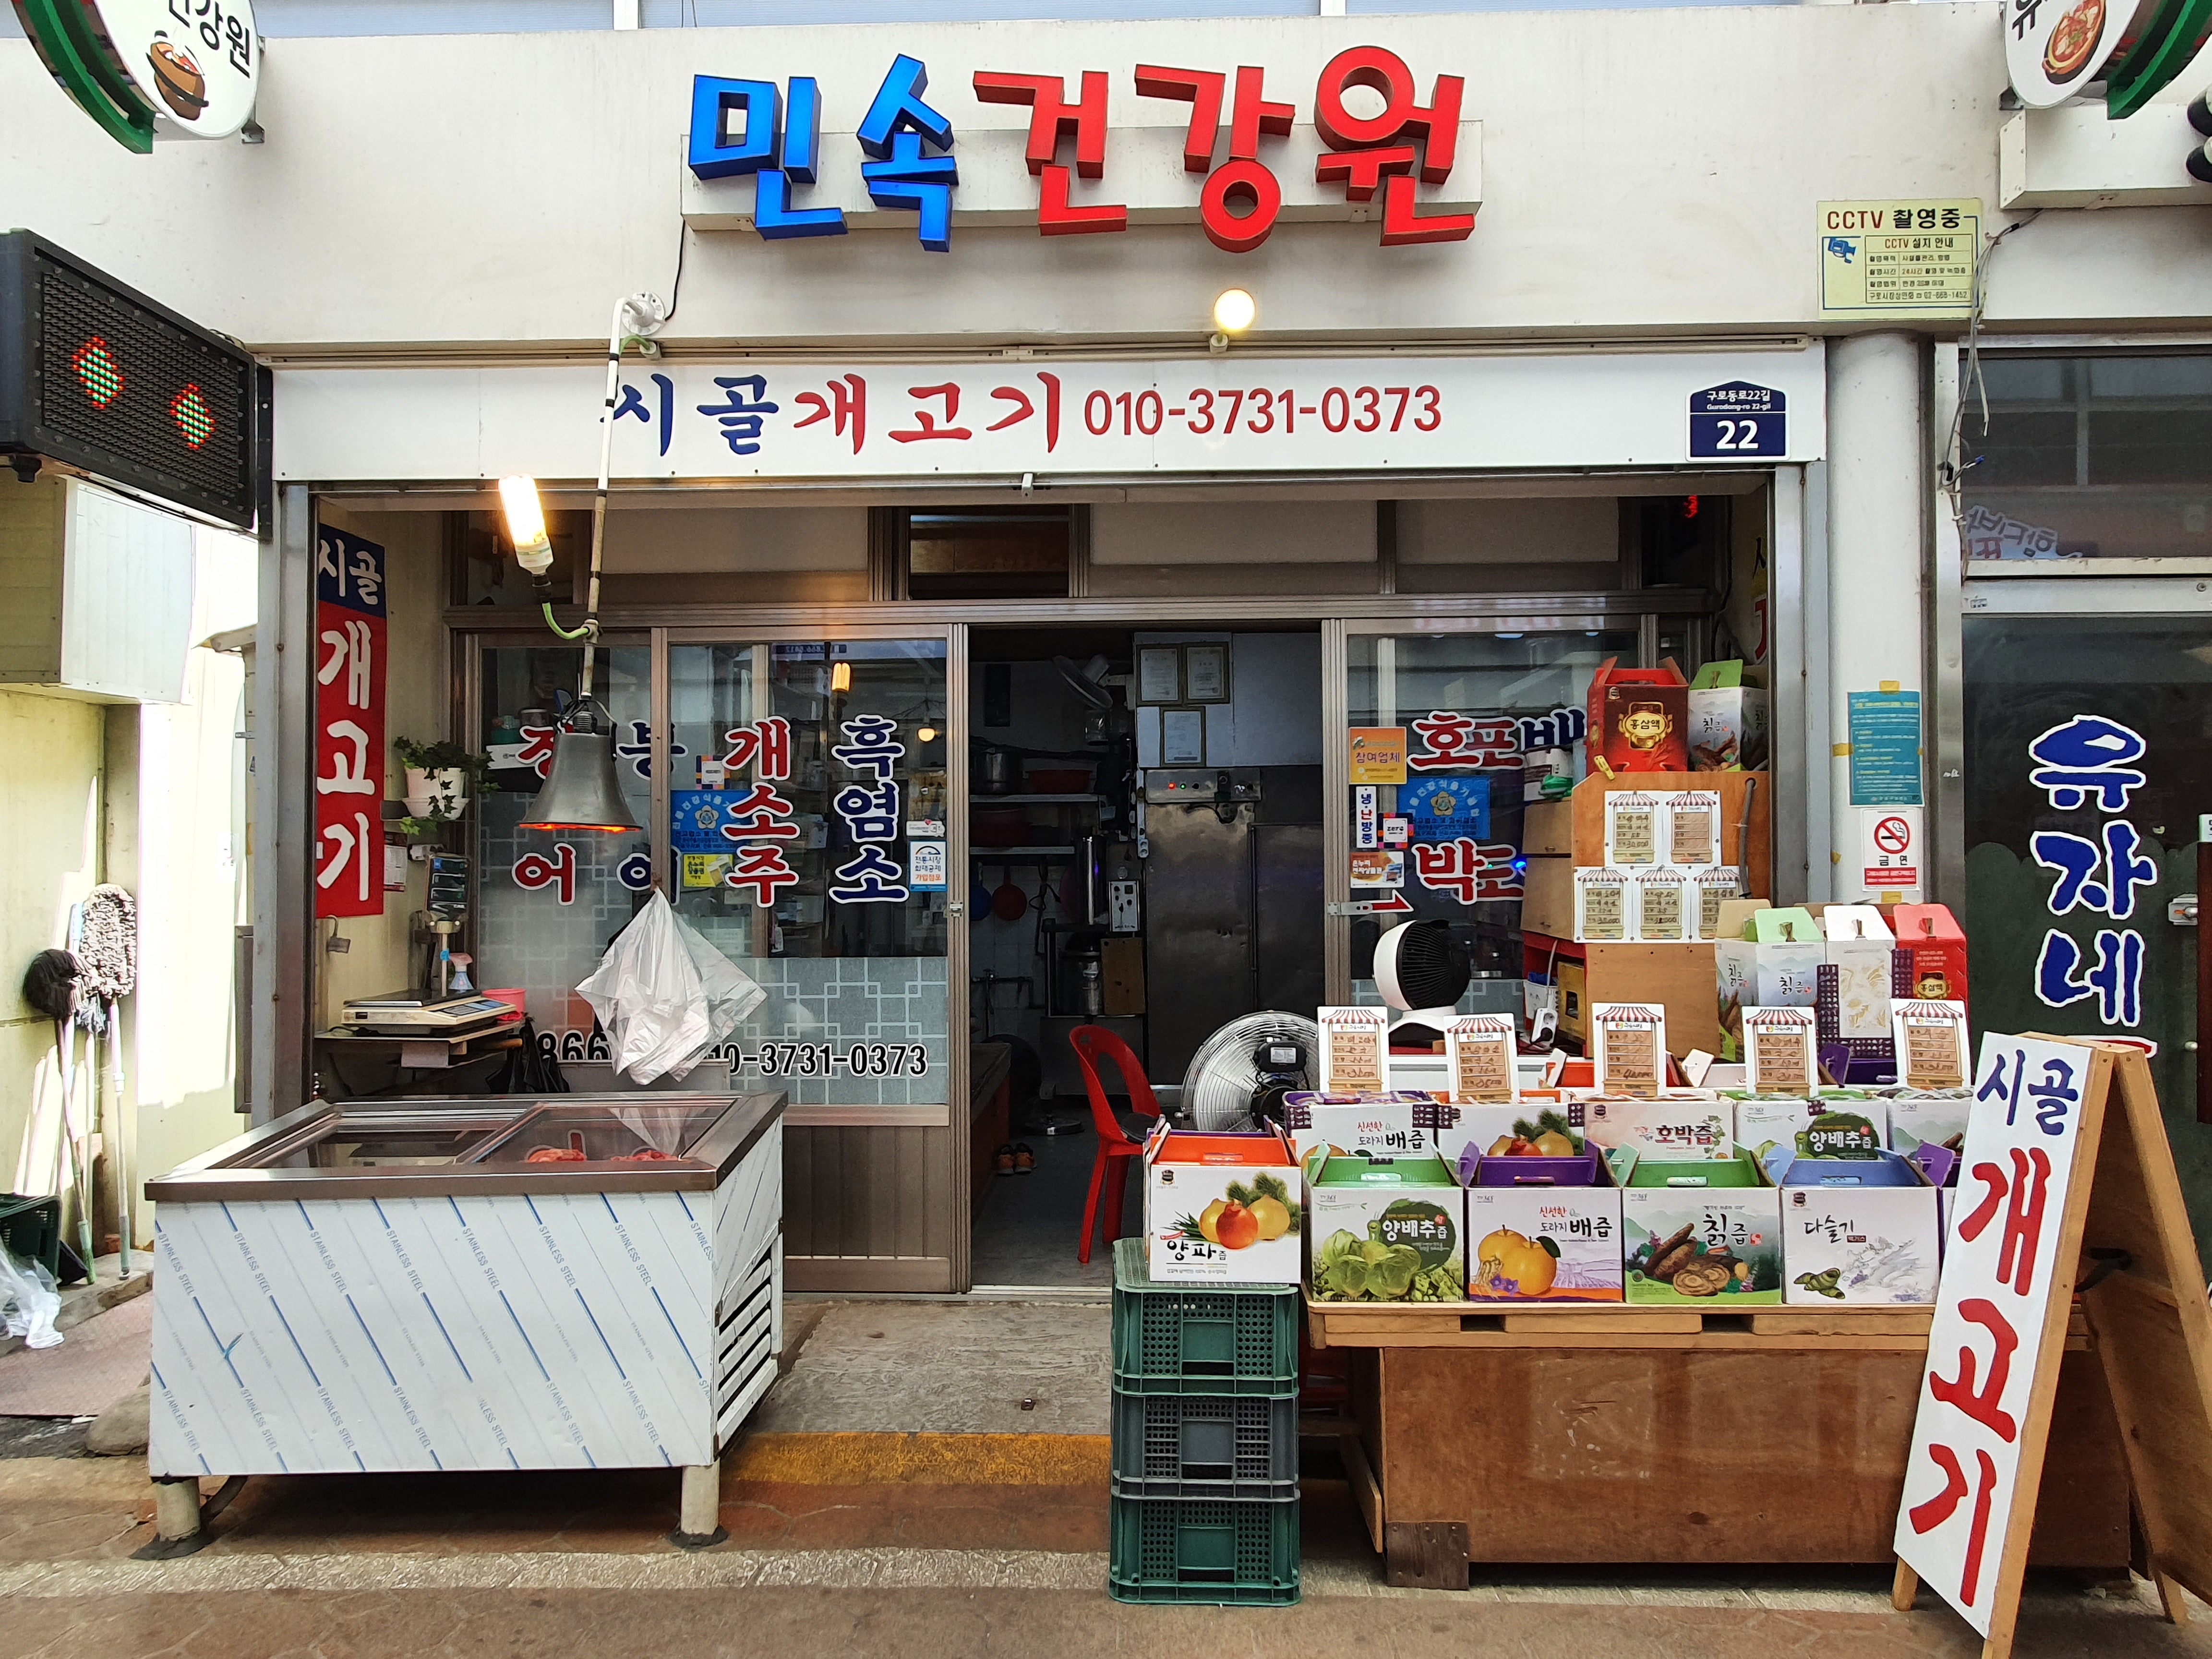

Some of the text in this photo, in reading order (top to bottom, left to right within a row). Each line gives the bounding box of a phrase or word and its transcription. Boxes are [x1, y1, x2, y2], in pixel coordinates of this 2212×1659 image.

[1827, 208, 1960, 229] CCTV 촬영중
[1885, 239, 1909, 248] CCTV
[1935, 238, 1953, 248] 안내
[1084, 385, 1442, 435] 010-3731-0373
[1707, 390, 1770, 402] 구로동로22길
[1716, 420, 1759, 450] 22
[318, 538, 382, 606] 시골
[1630, 719, 1660, 730] 홍삼액
[318, 620, 375, 902] 개고기
[1356, 752, 1400, 763] 참여업체
[722, 715, 800, 907] 개소주
[830, 713, 909, 904] 흑염소
[1977, 1049, 2079, 1135] 시골
[1358, 1121, 1382, 1132] 신선한
[1358, 1135, 1383, 1146] 도라지
[1655, 1125, 1713, 1145] 호박즙
[1539, 1206, 1567, 1218] 신선한
[1540, 1217, 1613, 1238] 도라지 배즙
[1804, 1214, 1854, 1244] 다슬기
[158, 1233, 194, 1296] STAINLESS STEEL
[234, 1232, 272, 1295] STAINLESS STEEL
[310, 1231, 348, 1294] STAINLESS STEEL
[387, 1230, 423, 1292] STAINLESS STEEL
[463, 1228, 501, 1290] STAINLESS STEEL
[539, 1226, 577, 1288] STAINLESS STEEL
[615, 1224, 652, 1286] STAINLESS STEEL
[1909, 1147, 2052, 1608] 개고기
[164, 1390, 188, 1429] STAINLESS
[184, 1430, 200, 1453] STEEL
[241, 1388, 266, 1428] STAINLESS
[261, 1429, 277, 1451] STEEL
[317, 1387, 342, 1427] STAINLESS
[338, 1427, 355, 1450] STEEL
[394, 1386, 419, 1426] STAINLESS
[414, 1426, 431, 1449] STEEL
[492, 1424, 509, 1447] STEEL
[546, 1382, 572, 1421] STAINLESS
[568, 1422, 584, 1446] STEEL
[623, 1380, 649, 1420] STAINLESS
[644, 1420, 660, 1444] STEEL
